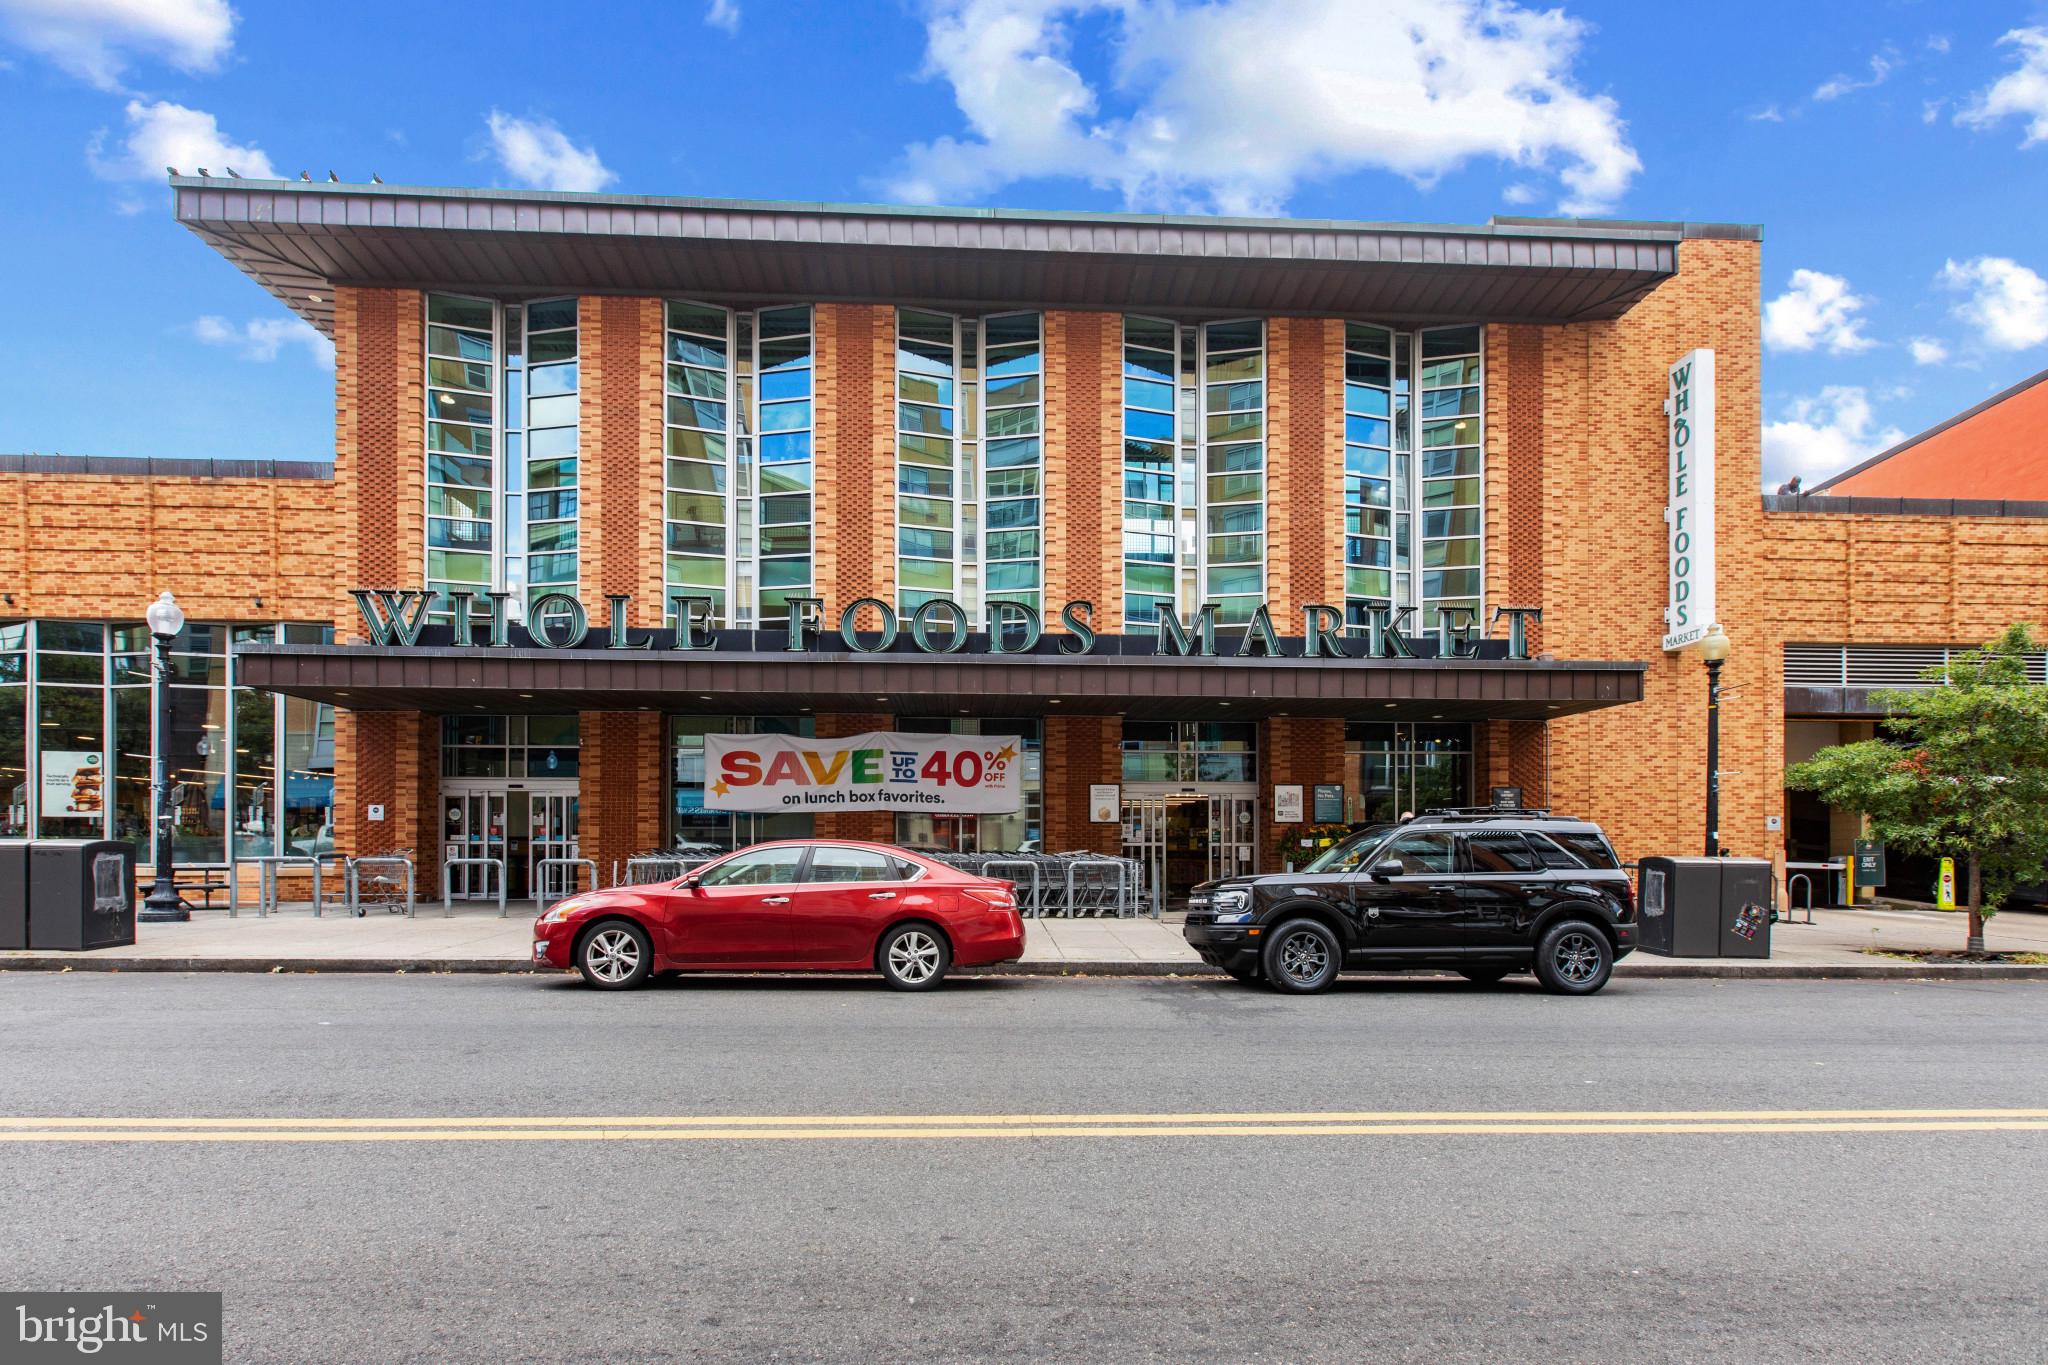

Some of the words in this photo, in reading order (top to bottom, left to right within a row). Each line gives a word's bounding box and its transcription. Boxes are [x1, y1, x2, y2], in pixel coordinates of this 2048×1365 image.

[1672, 362, 1692, 497] WHOLE
[1674, 507, 1690, 626] FOODS
[350, 590, 718, 650] WHOLE
[783, 597, 1097, 656] FOODS
[1151, 602, 1543, 661] MARKET
[1665, 628, 1700, 648] MARKET
[720, 748, 885, 788] SAVE
[892, 756, 917, 768] UP
[891, 768, 916, 779] TO
[984, 773, 1006, 782] OFF
[782, 794, 802, 805] on
[804, 789, 845, 804] lunch
[848, 789, 876, 803] box
[877, 788, 945, 804] favorites.
